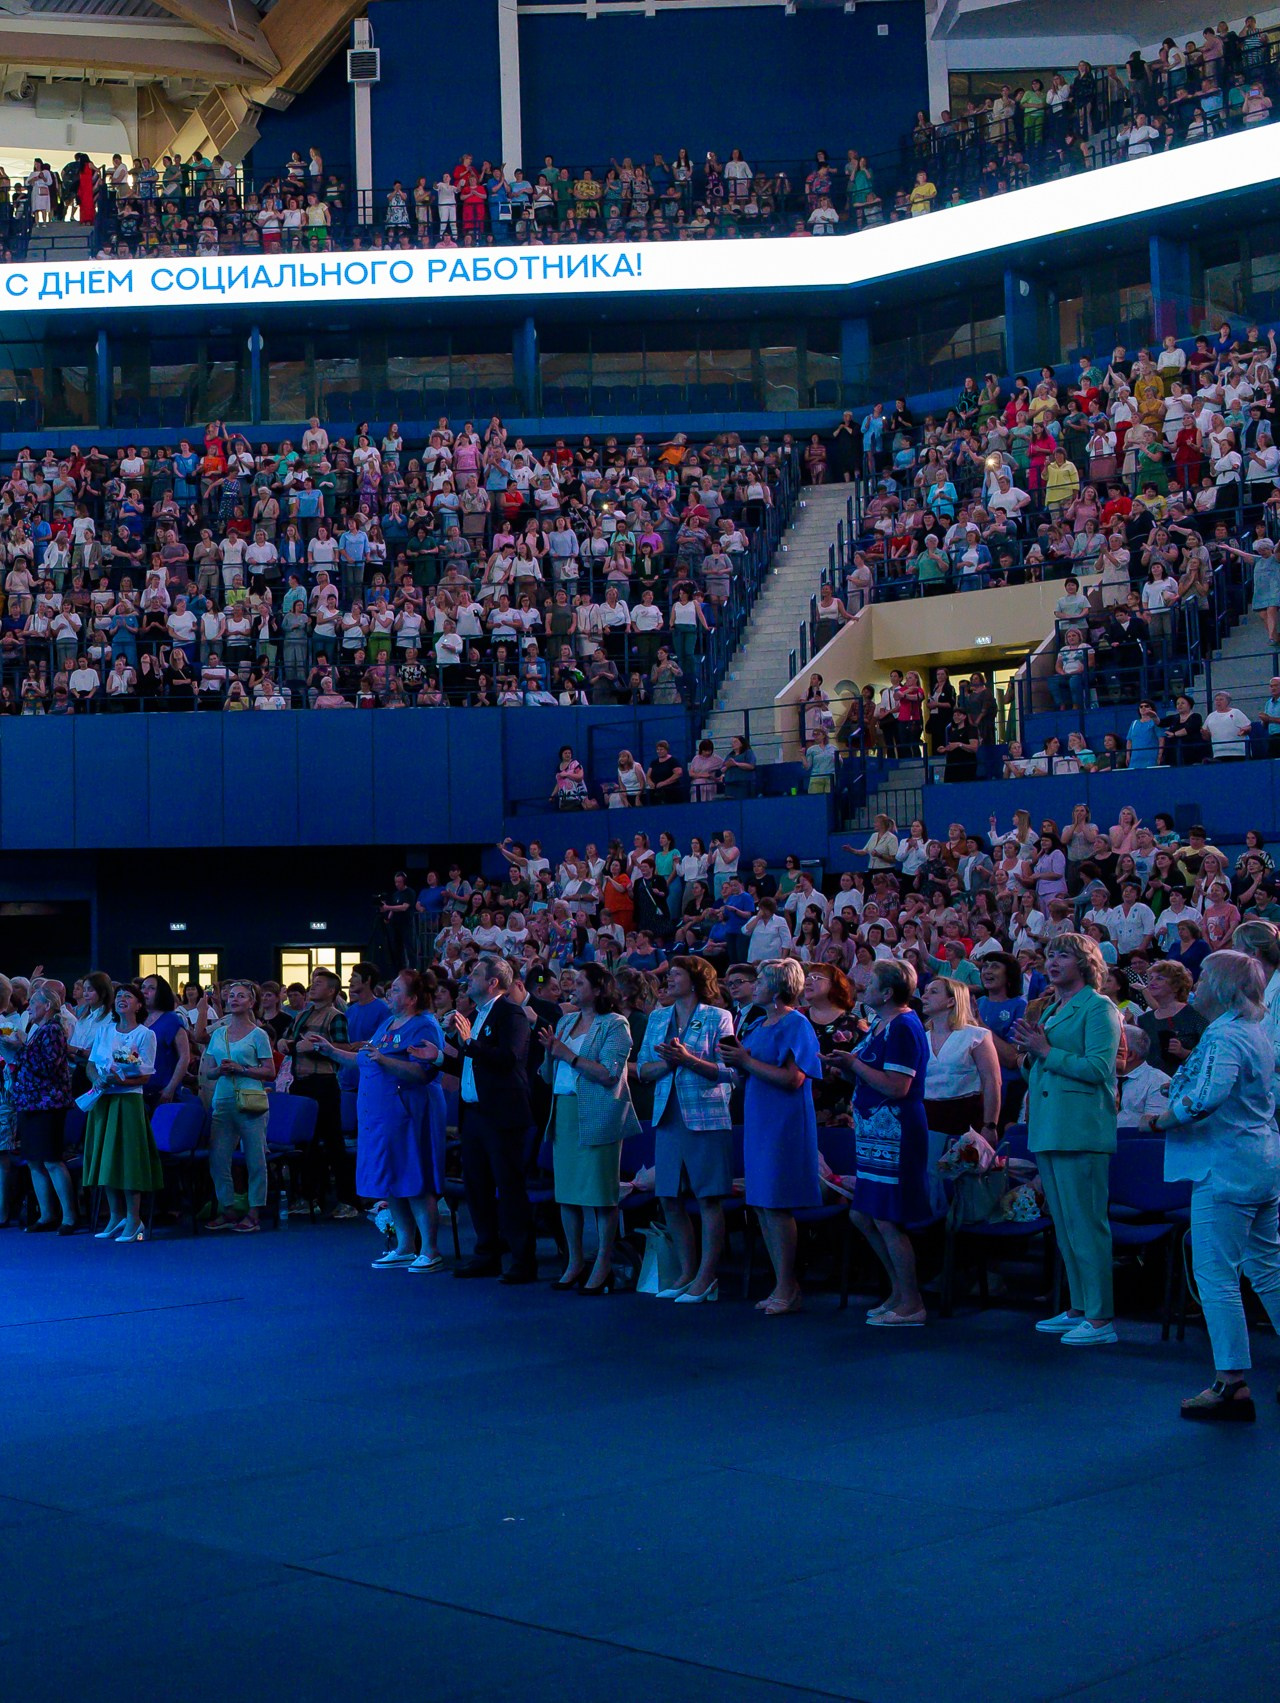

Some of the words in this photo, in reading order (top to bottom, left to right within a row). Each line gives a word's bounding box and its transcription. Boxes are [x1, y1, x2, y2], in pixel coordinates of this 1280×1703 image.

[5, 273, 29, 297] С
[150, 259, 414, 295] СОЦИАЛЬНОГО
[427, 252, 642, 283] РАБОТНИКА!
